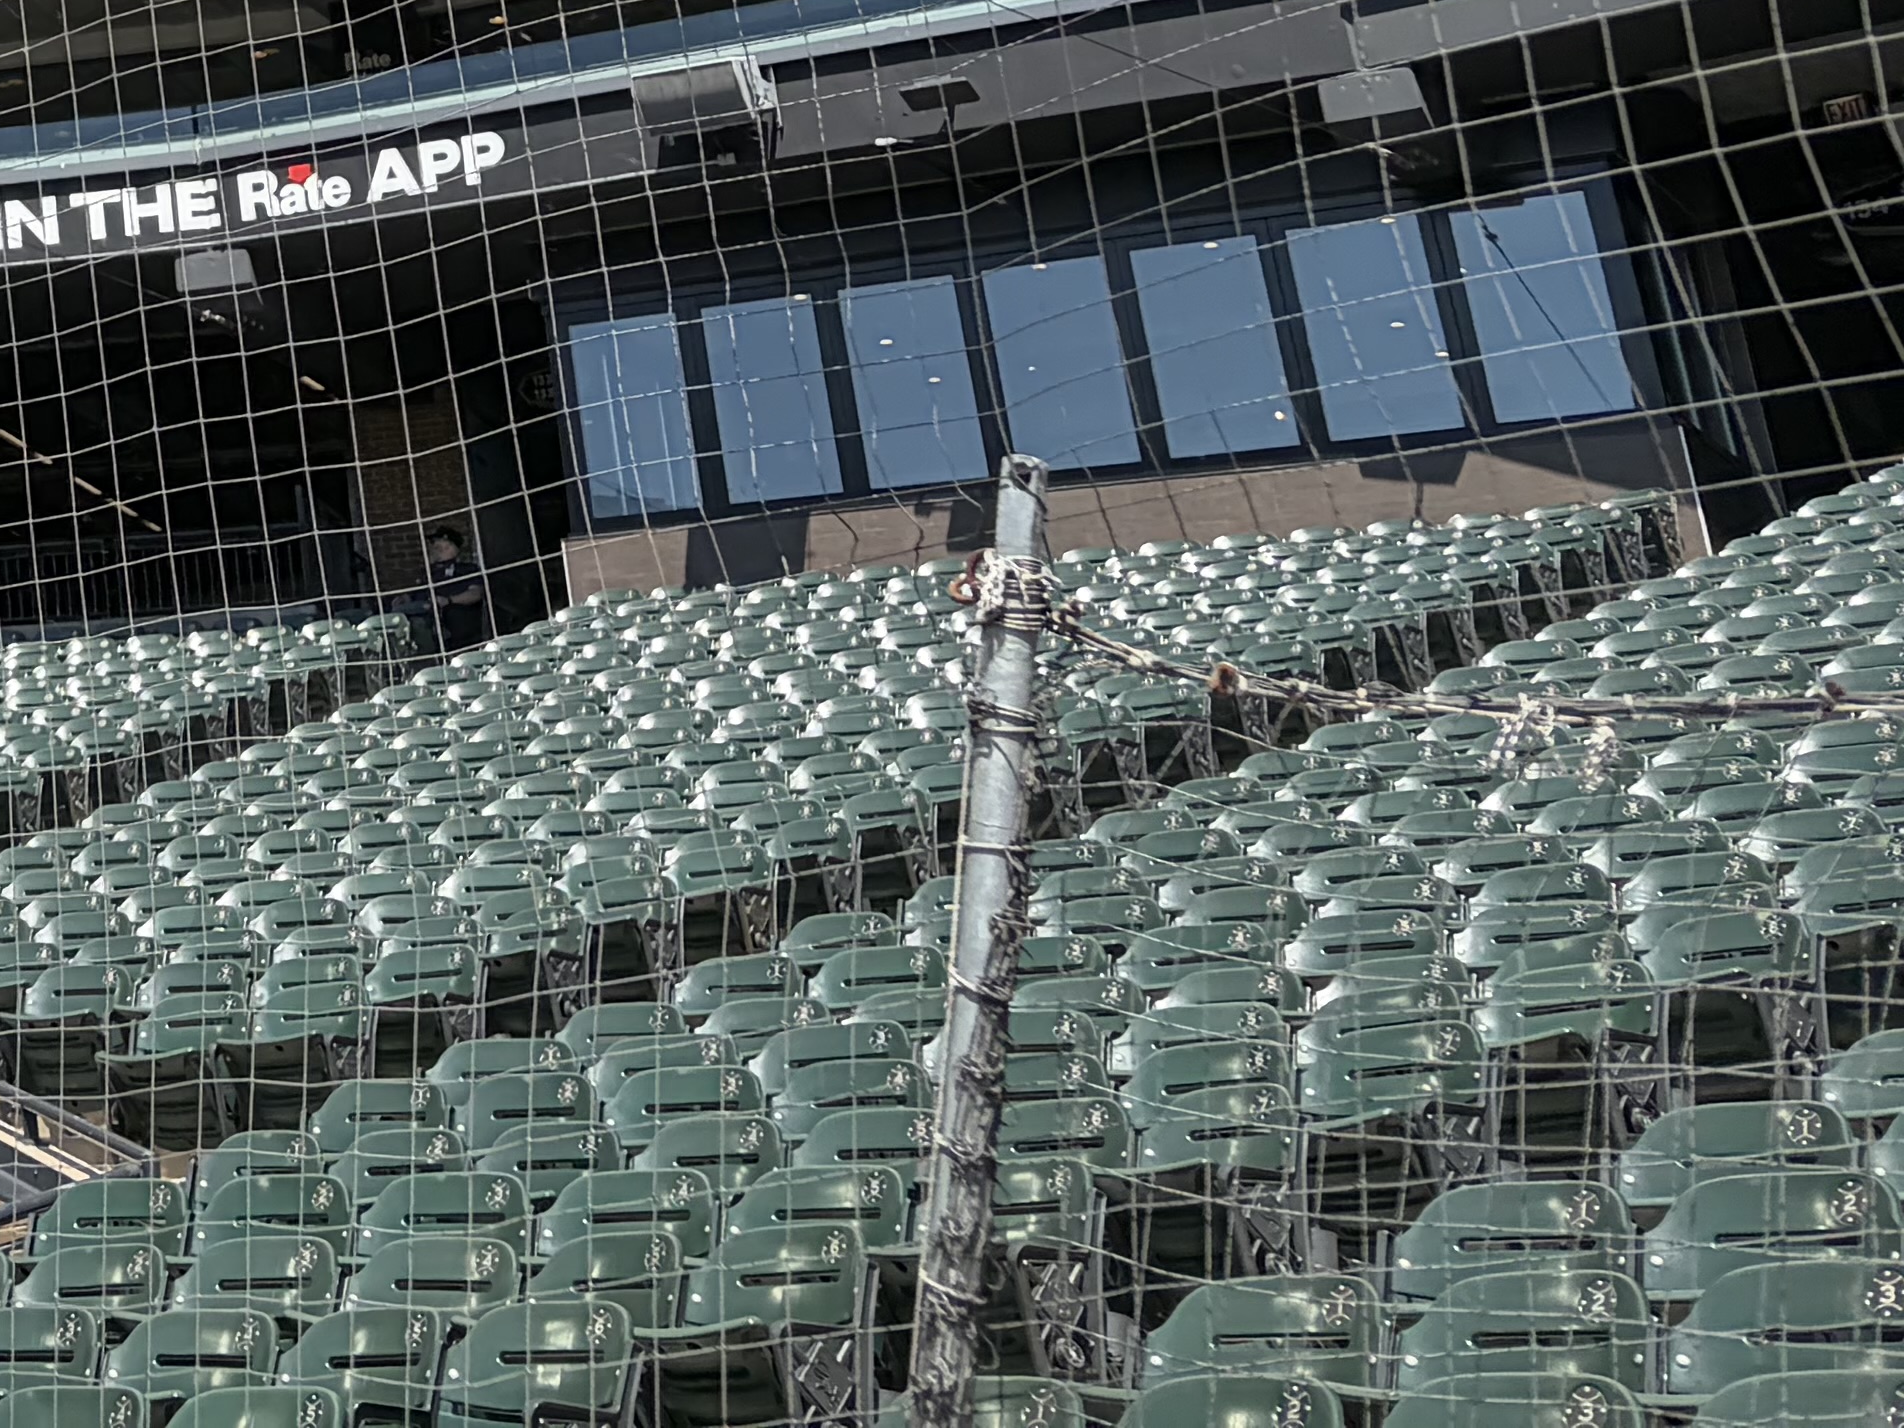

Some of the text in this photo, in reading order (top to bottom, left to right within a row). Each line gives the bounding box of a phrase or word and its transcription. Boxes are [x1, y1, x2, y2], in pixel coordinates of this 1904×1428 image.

[1829, 98, 1864, 123] EXIT
[70, 176, 218, 241] THE
[238, 166, 352, 222] Rate
[366, 130, 506, 204] APP
